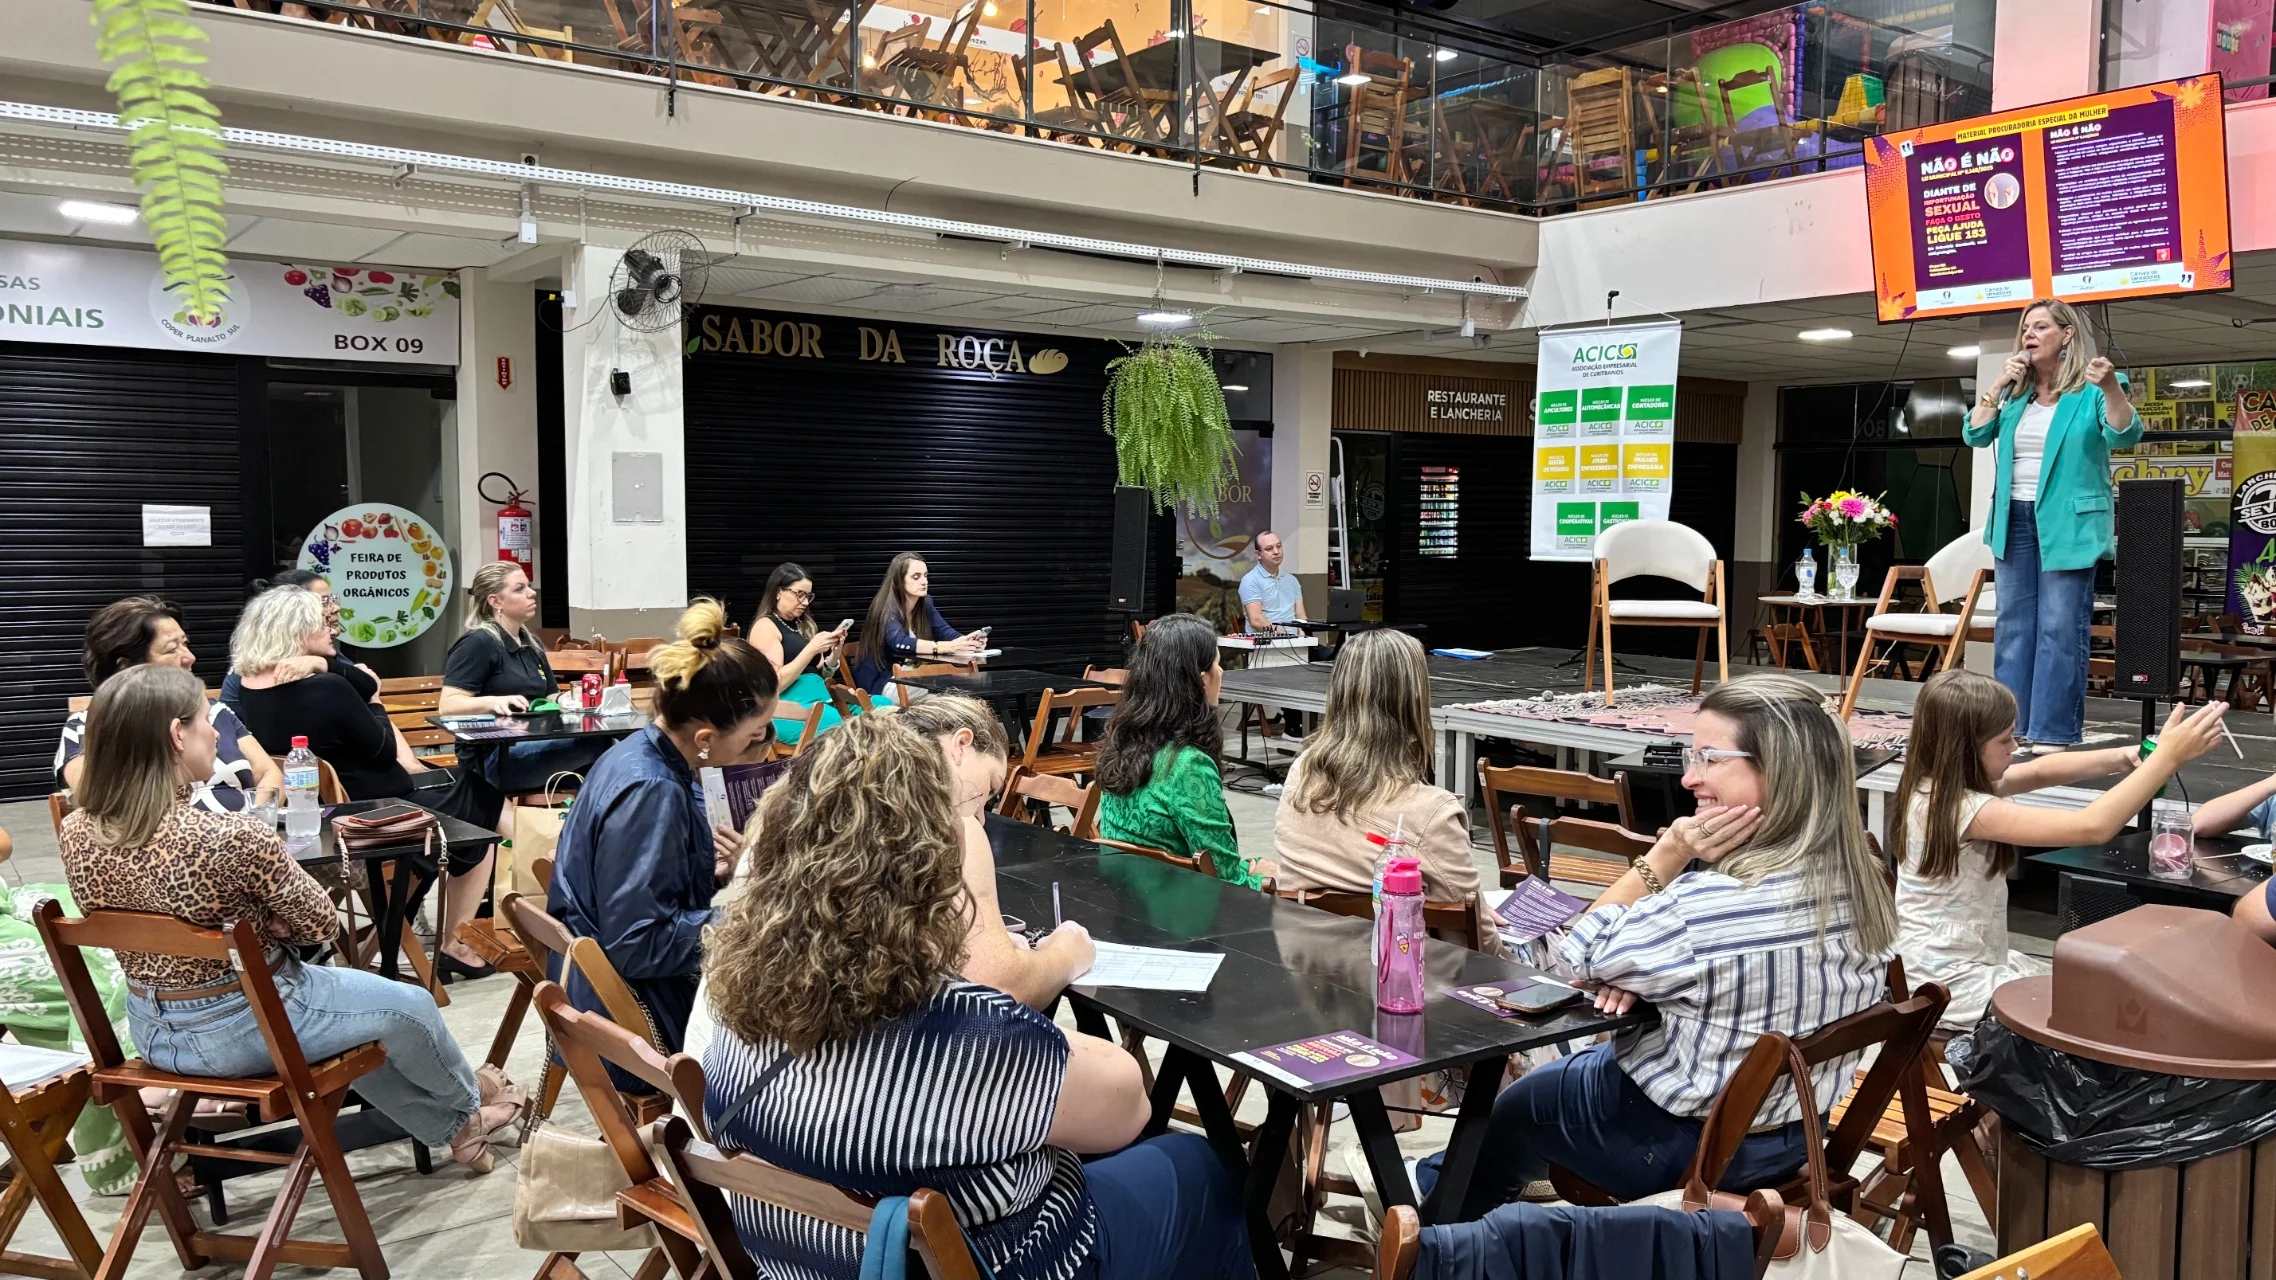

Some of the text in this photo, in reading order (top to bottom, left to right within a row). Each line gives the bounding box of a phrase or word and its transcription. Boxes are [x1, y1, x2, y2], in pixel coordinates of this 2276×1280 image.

[1957, 108, 2107, 140] MATERIAL PROCURADORIA ESPECIAL DA MULHER
[1921, 147, 2015, 175] NÃO É NÃO
[1923, 182, 1977, 199] DIANTE DE
[1924, 200, 1981, 217] SEXUAL
[1925, 218, 1946, 227] FAÇA
[1954, 212, 1981, 221] GESTO
[1926, 220, 1984, 235] PEÇA AJUDA
[1927, 228, 1987, 245] LIGUE 153
[0, 303, 104, 329] NIAIS
[161, 318, 241, 343] COPER PLANALTO SUL
[333, 334, 424, 354] BOX 09
[701, 313, 1027, 380] SABOR DA ROÇA
[1571, 362, 1638, 372] ASSOCIAÇÃO EMPRESARIAL
[1427, 389, 1506, 406] RESTAURANTE
[1631, 401, 1669, 409] CONTADORES
[1430, 406, 1503, 421] E LANCHERIA
[1581, 403, 1621, 411] AUTOMECÂNICAS
[2251, 414, 2272, 432] DE
[2110, 458, 2214, 496] chry
[350, 552, 402, 563] FEIRA DE
[346, 570, 407, 581] PRODUTOS
[342, 587, 410, 598] ORGÂNICOS
